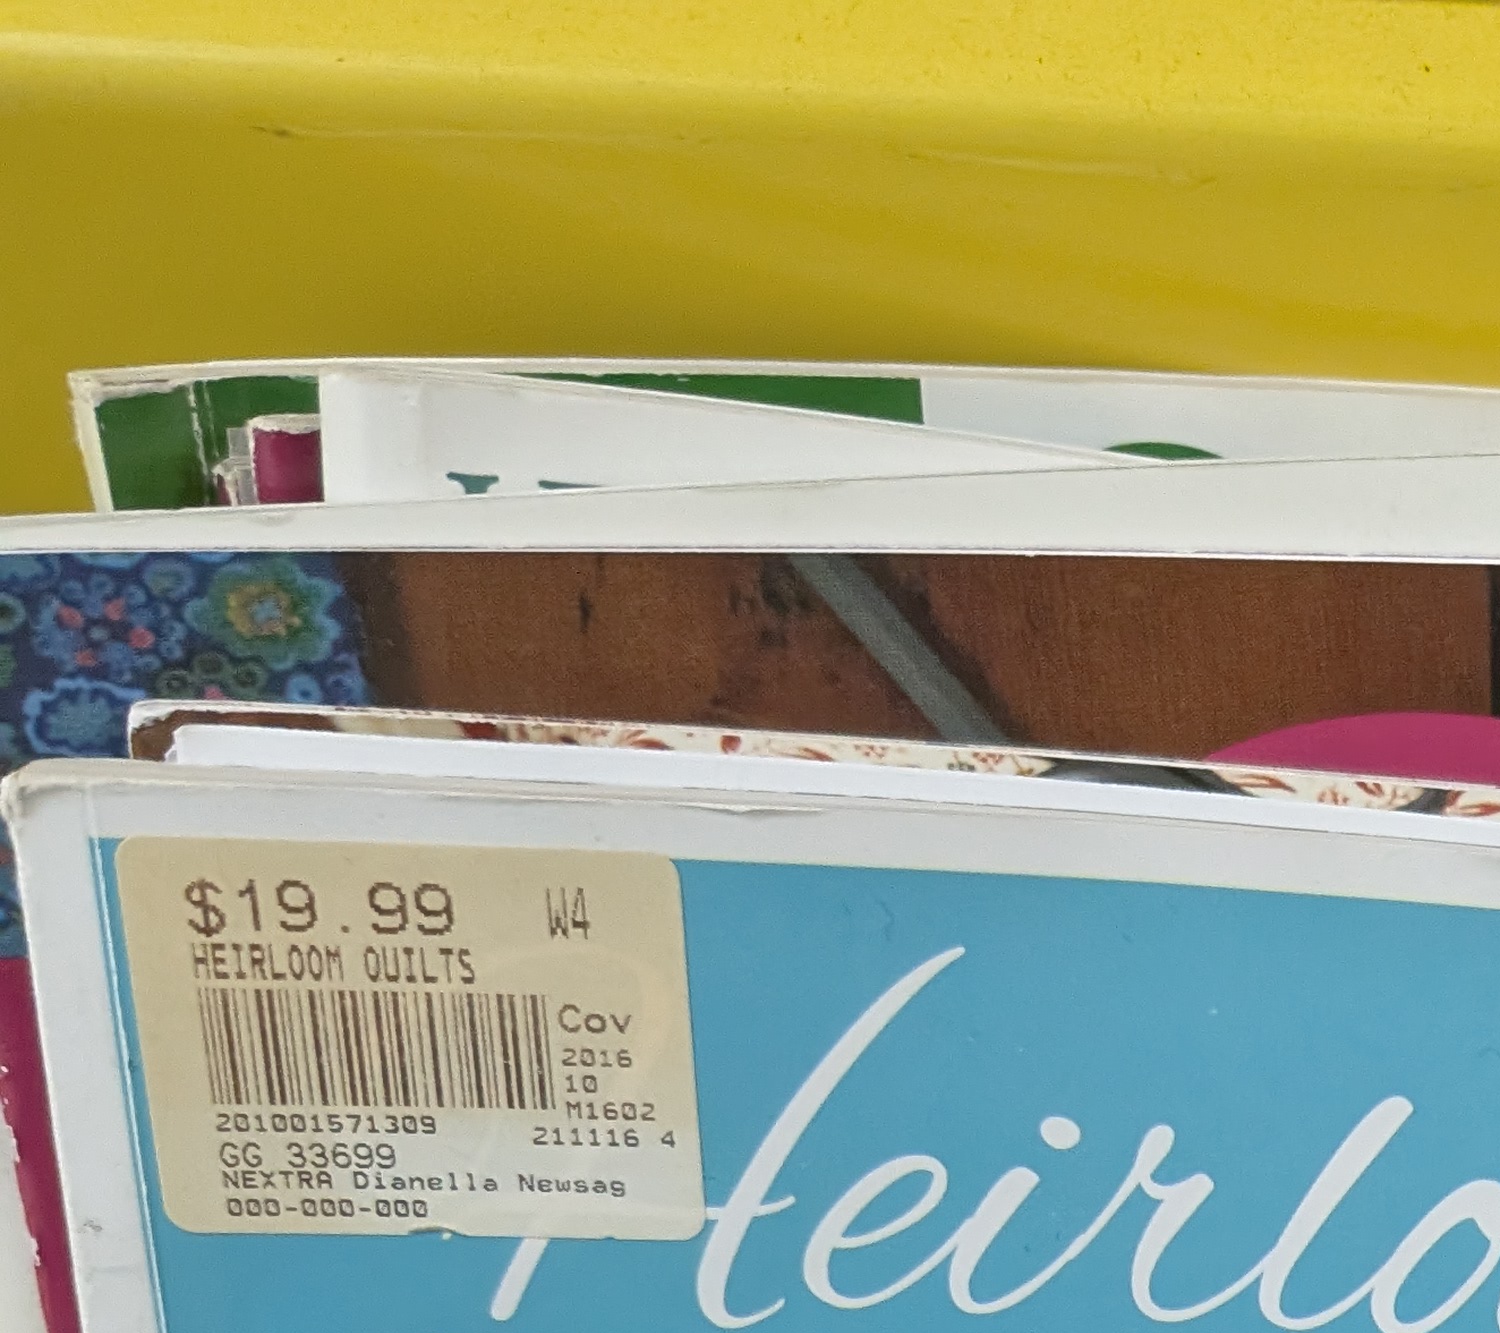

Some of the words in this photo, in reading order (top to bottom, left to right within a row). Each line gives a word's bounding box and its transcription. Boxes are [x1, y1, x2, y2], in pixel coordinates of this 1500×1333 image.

[185, 879, 455, 937] $19.99
[545, 886, 592, 940] W4
[192, 942, 344, 982] HEIRLOOM
[364, 944, 476, 985] QUILTS
[558, 1004, 632, 1034] Cov
[562, 1048, 633, 1068] 2016
[566, 1074, 598, 1094] 10
[566, 1101, 656, 1122] M1602
[216, 1112, 437, 1135] 201001571309
[533, 1126, 640, 1148] 211116
[661, 1130, 676, 1148] 4
[219, 1142, 263, 1168] GG
[287, 1142, 396, 1169] 33699
[222, 1169, 333, 1190] NEXTRA
[353, 1171, 499, 1192] Dianella
[517, 1173, 627, 1198] Newsag
[226, 1197, 428, 1218] 000-000-000
